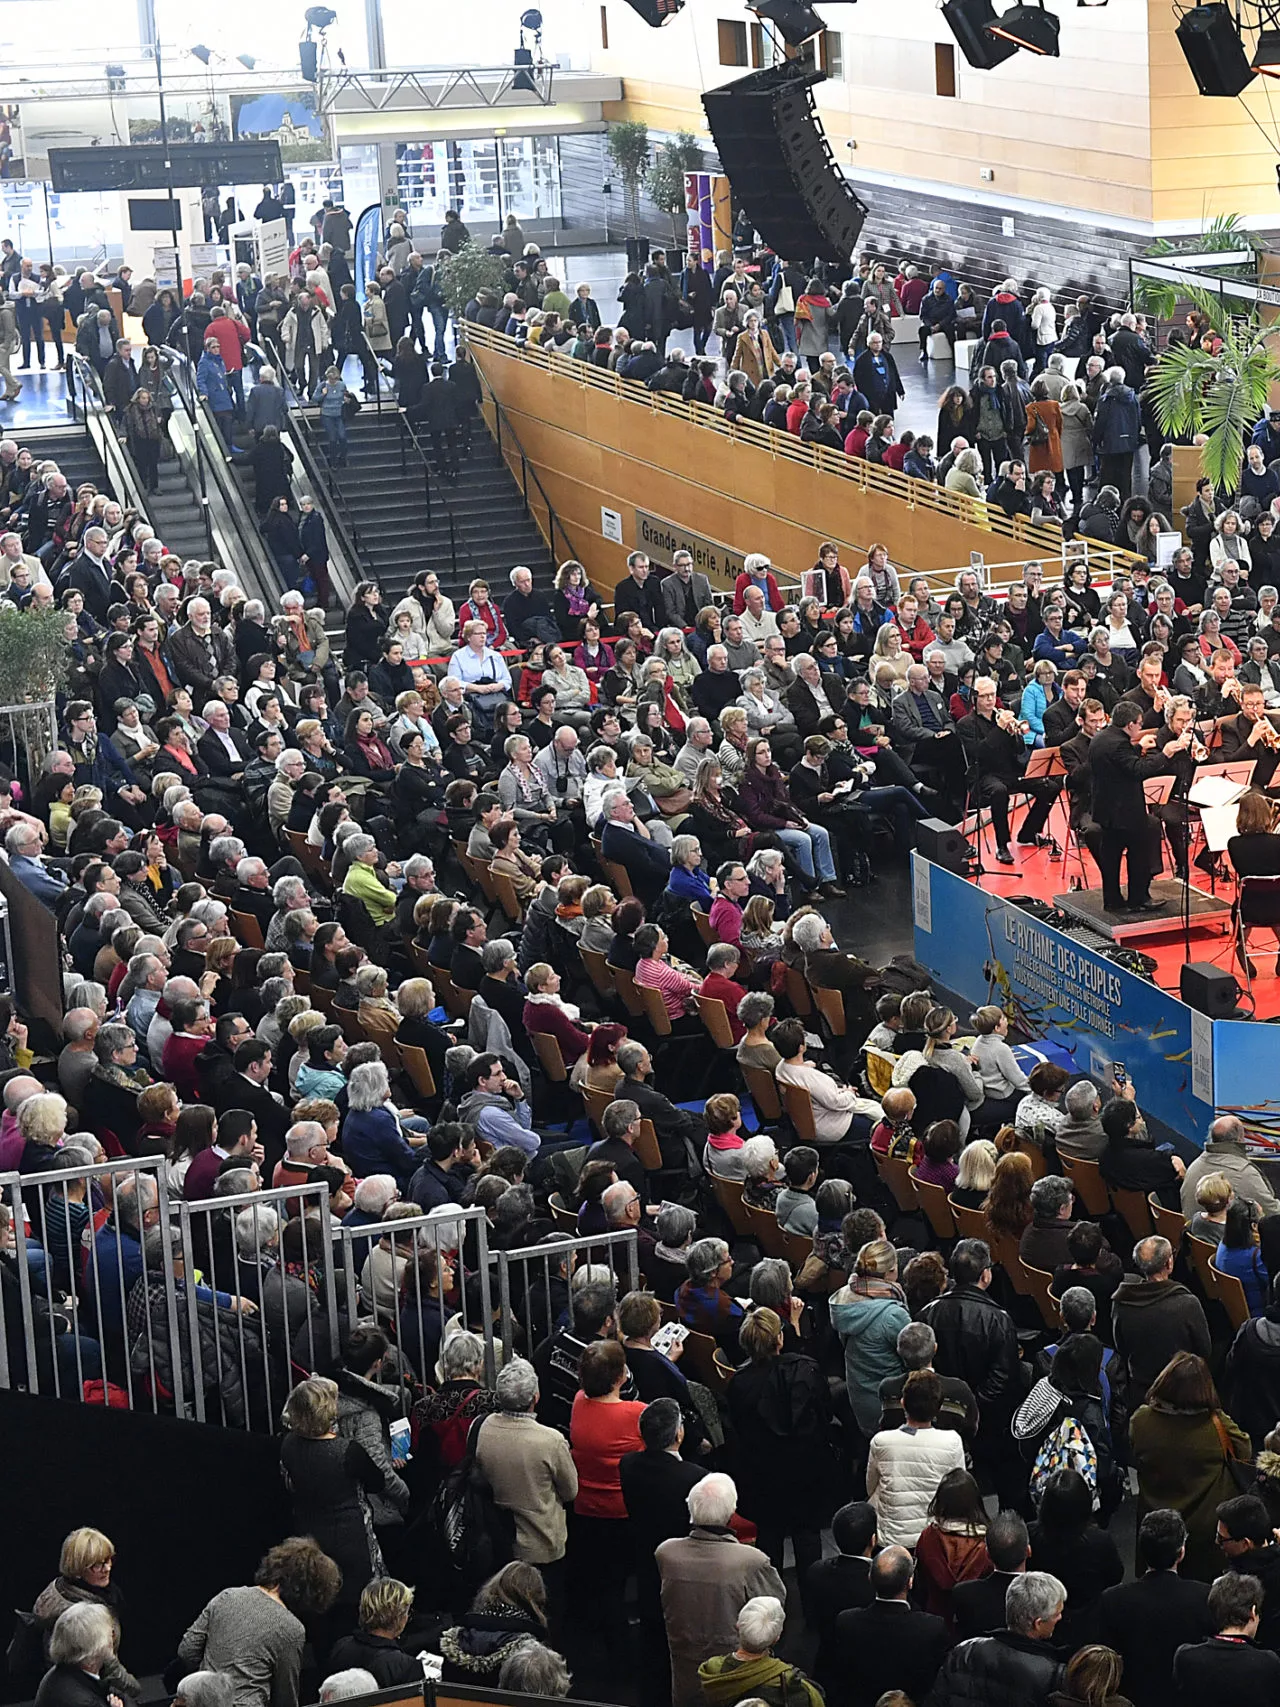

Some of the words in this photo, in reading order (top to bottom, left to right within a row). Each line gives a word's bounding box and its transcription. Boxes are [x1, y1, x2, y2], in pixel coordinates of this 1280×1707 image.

[642, 520, 677, 552] Grande
[1005, 911, 1016, 944] LE
[1018, 922, 1056, 968] RYTHME
[1058, 944, 1076, 979] DES
[1078, 955, 1121, 1006] PEUPLES
[1071, 998, 1088, 1023] FOLLE
